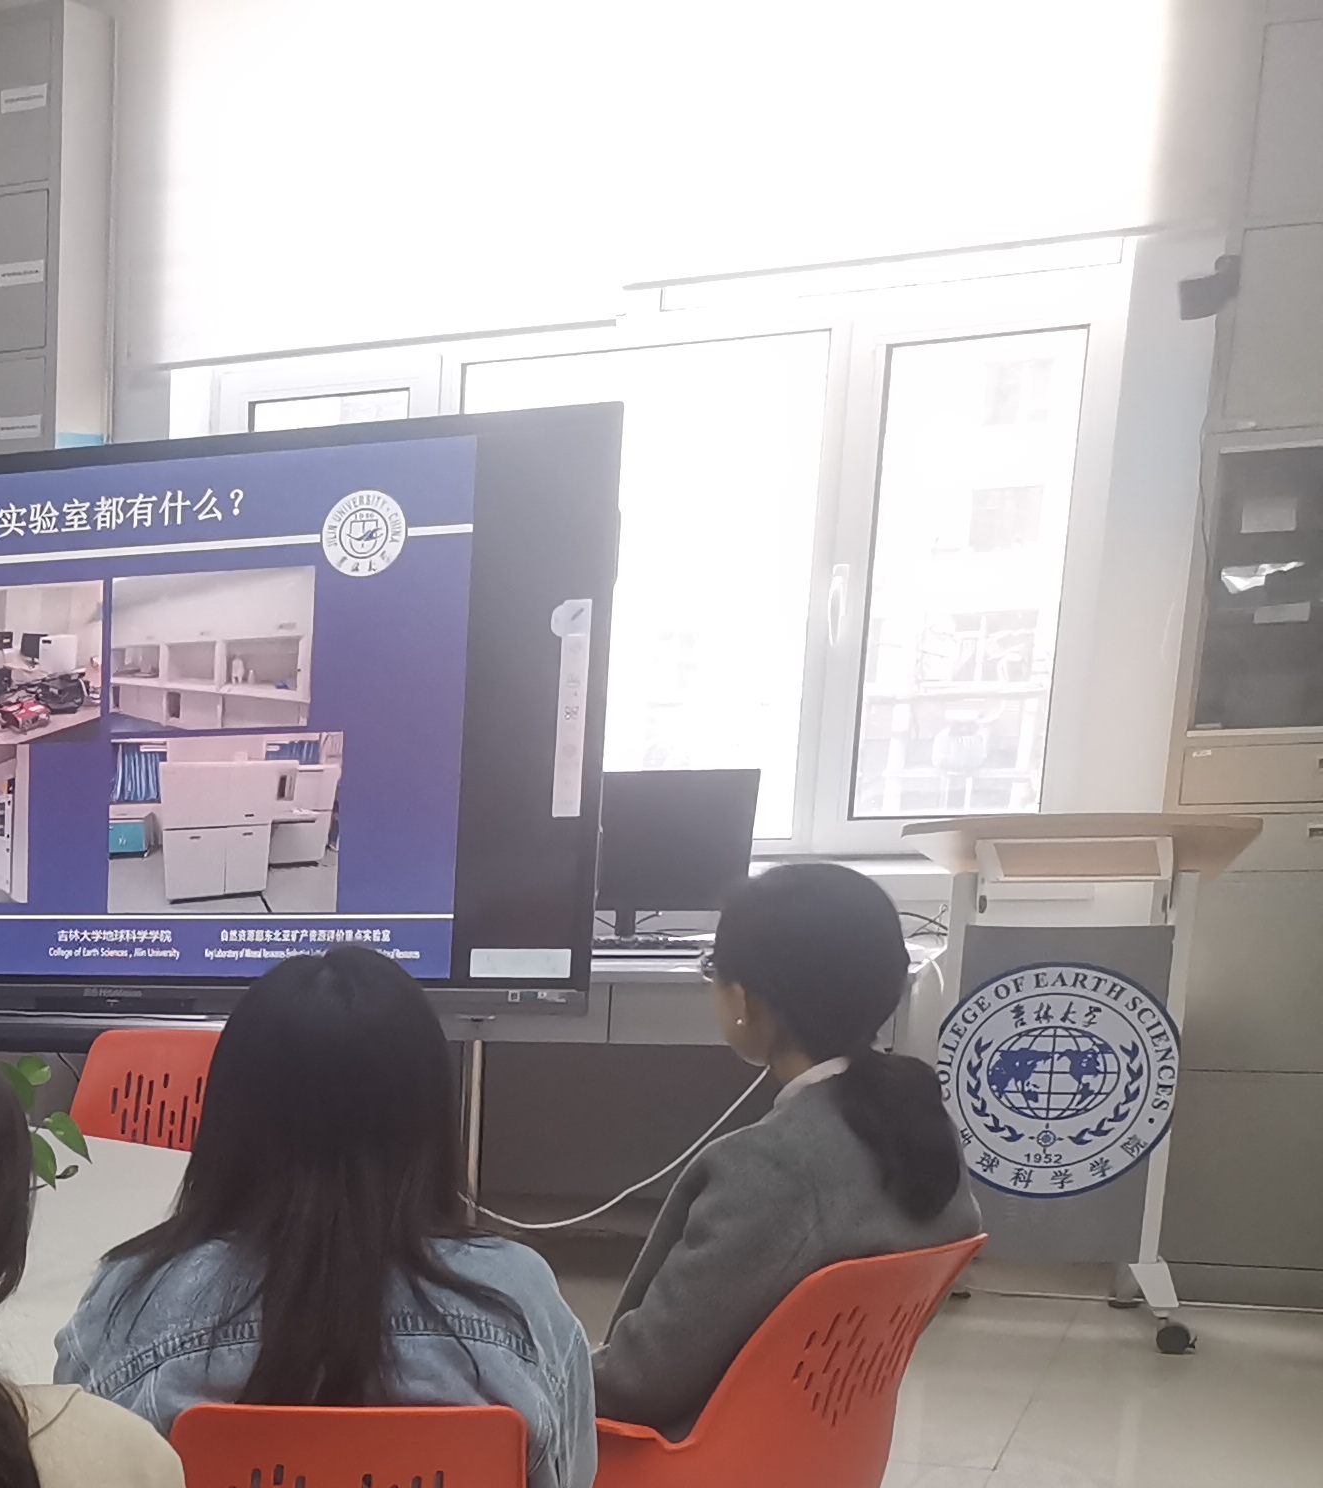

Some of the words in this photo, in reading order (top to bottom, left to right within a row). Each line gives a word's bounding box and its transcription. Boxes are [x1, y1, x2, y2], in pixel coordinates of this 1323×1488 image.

[57, 929, 172, 942] 吉林大学地球科学学院
[48, 948, 73, 959] College
[74, 948, 82, 957] of
[82, 948, 99, 957] Earth
[147, 948, 180, 960] University
[1010, 1001, 1103, 1029] 吉林大学
[993, 976, 1025, 1000] OF
[1034, 971, 1128, 1002] EARTH
[1124, 995, 1176, 1112] SCIENCES
[1023, 1152, 1064, 1165] 1952
